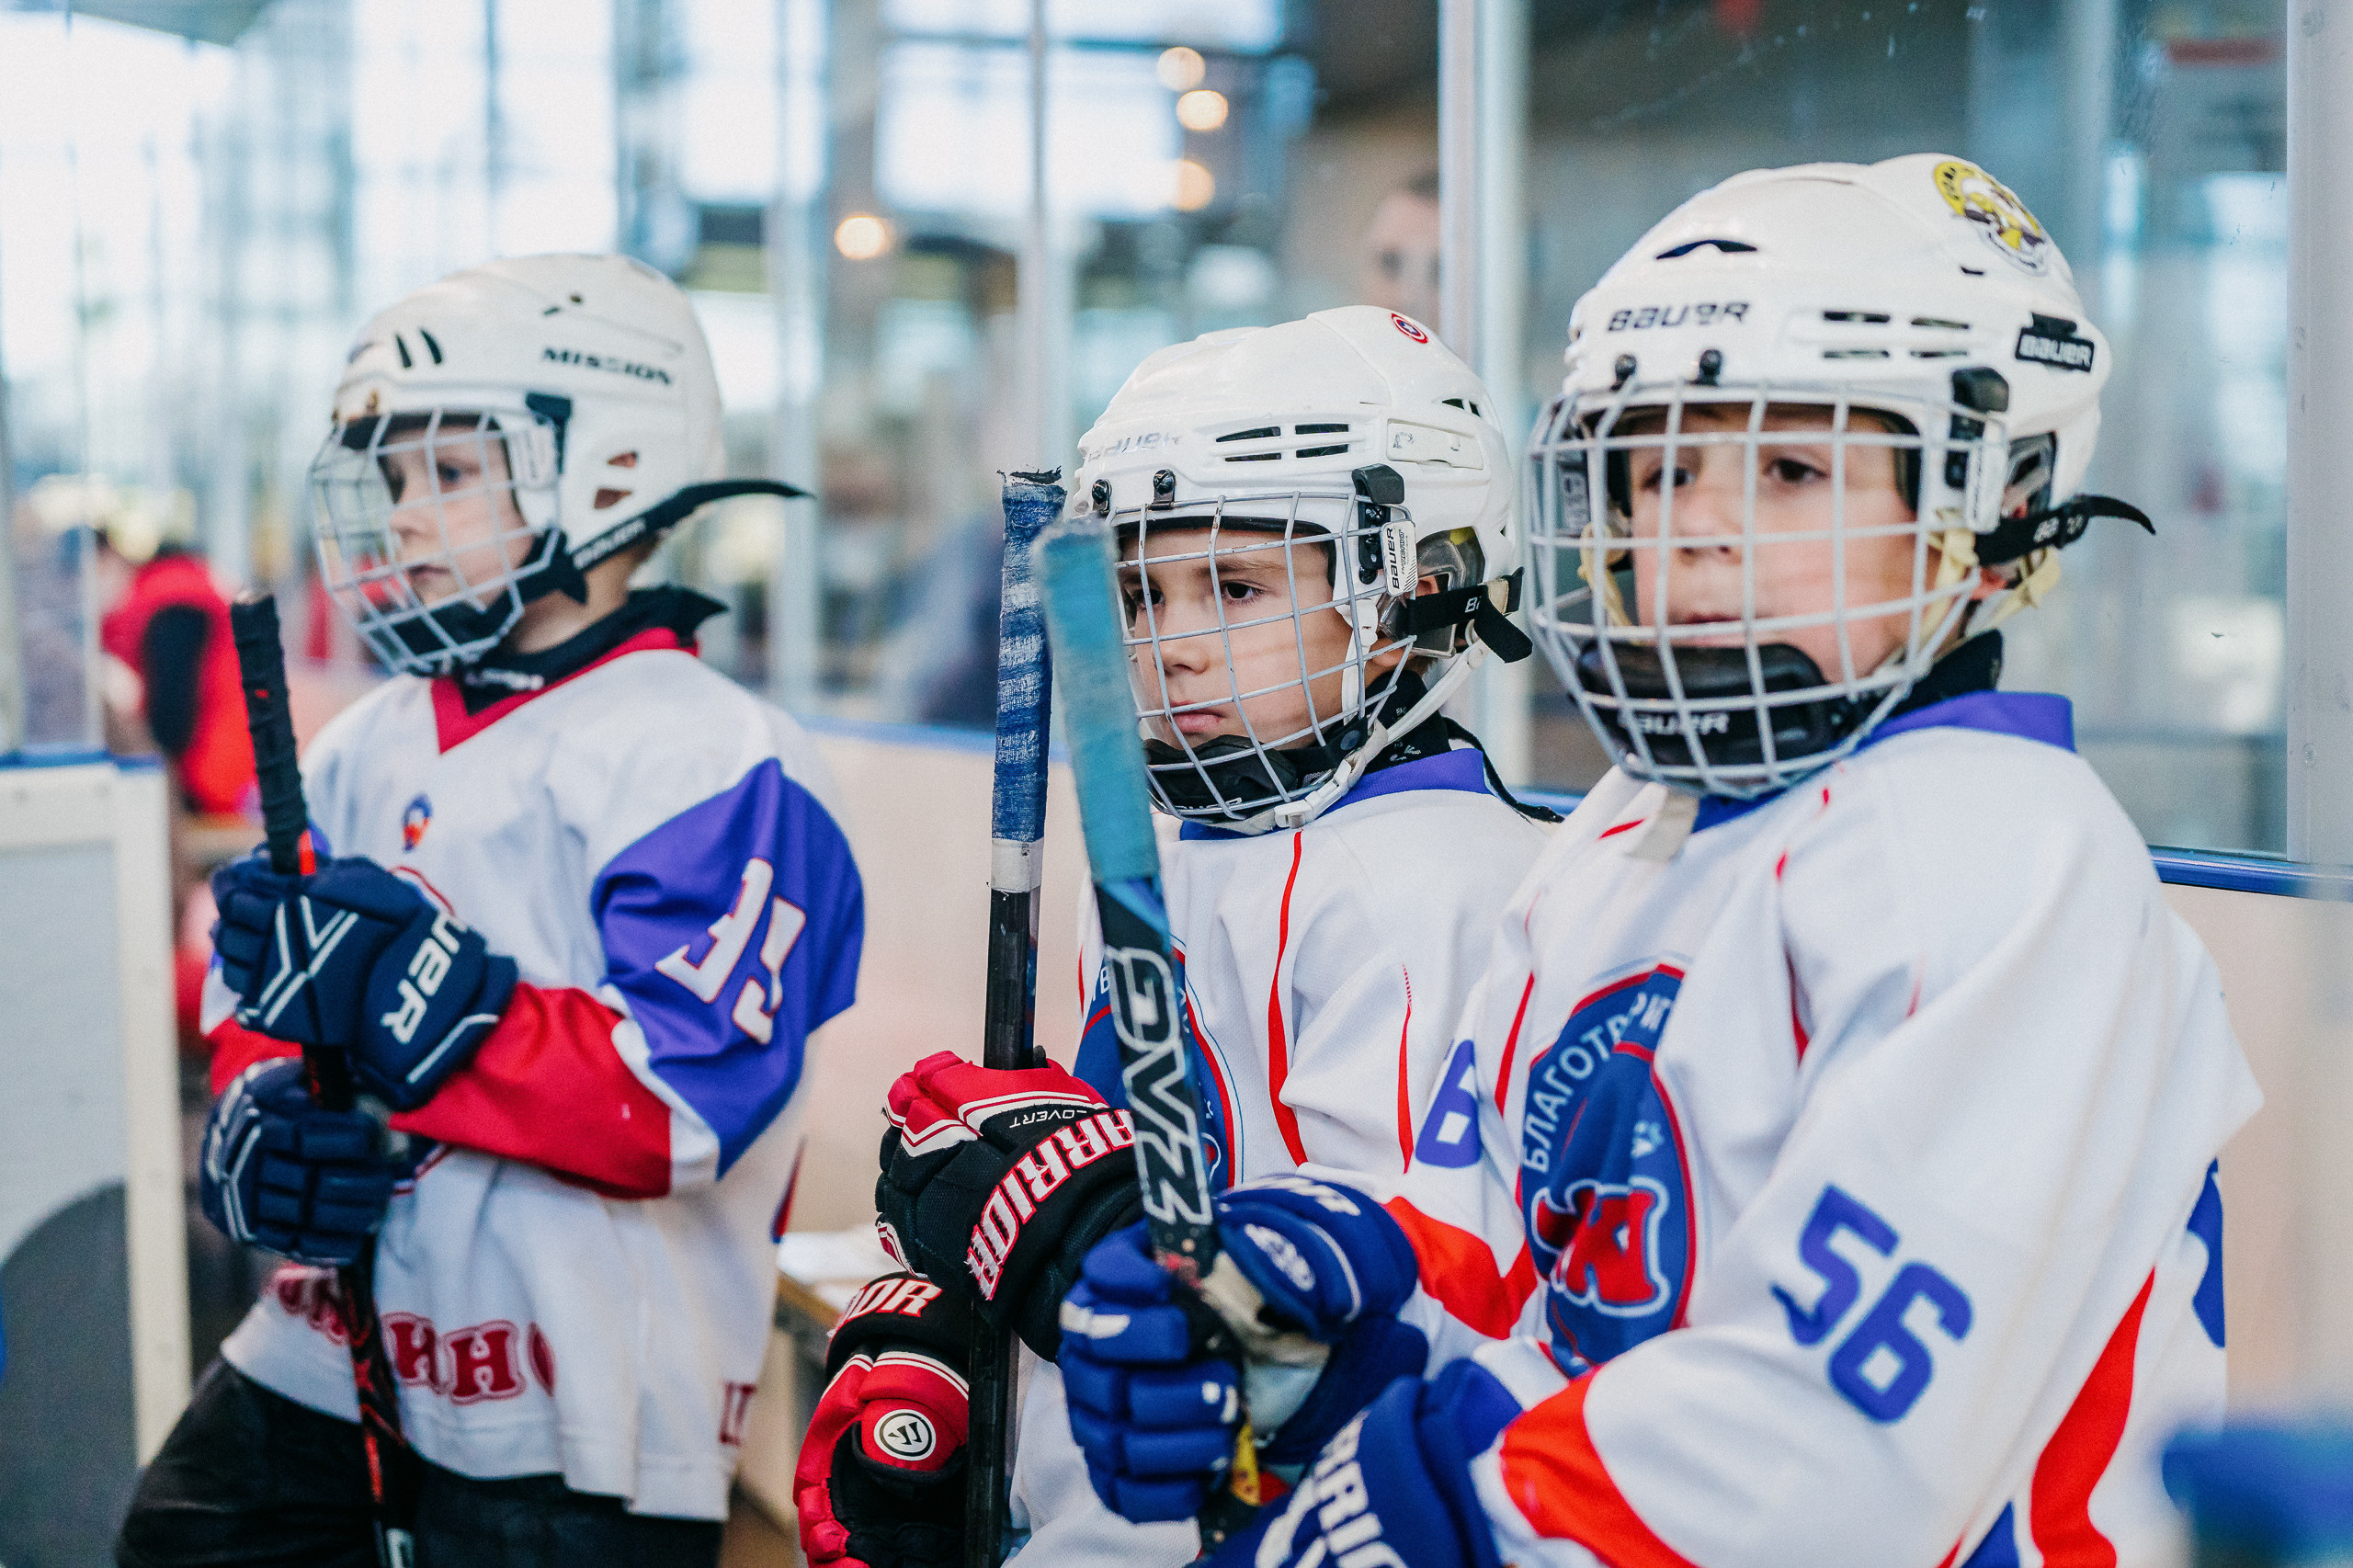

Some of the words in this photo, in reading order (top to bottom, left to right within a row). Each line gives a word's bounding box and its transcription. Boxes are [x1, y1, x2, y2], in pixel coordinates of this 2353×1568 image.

[1385, 527, 1401, 590] BAUER
[380, 912, 467, 1044] UER
[1415, 1039, 1483, 1169] 6
[967, 1108, 1137, 1301] ARRIOR
[1769, 1183, 1973, 1425] 56
